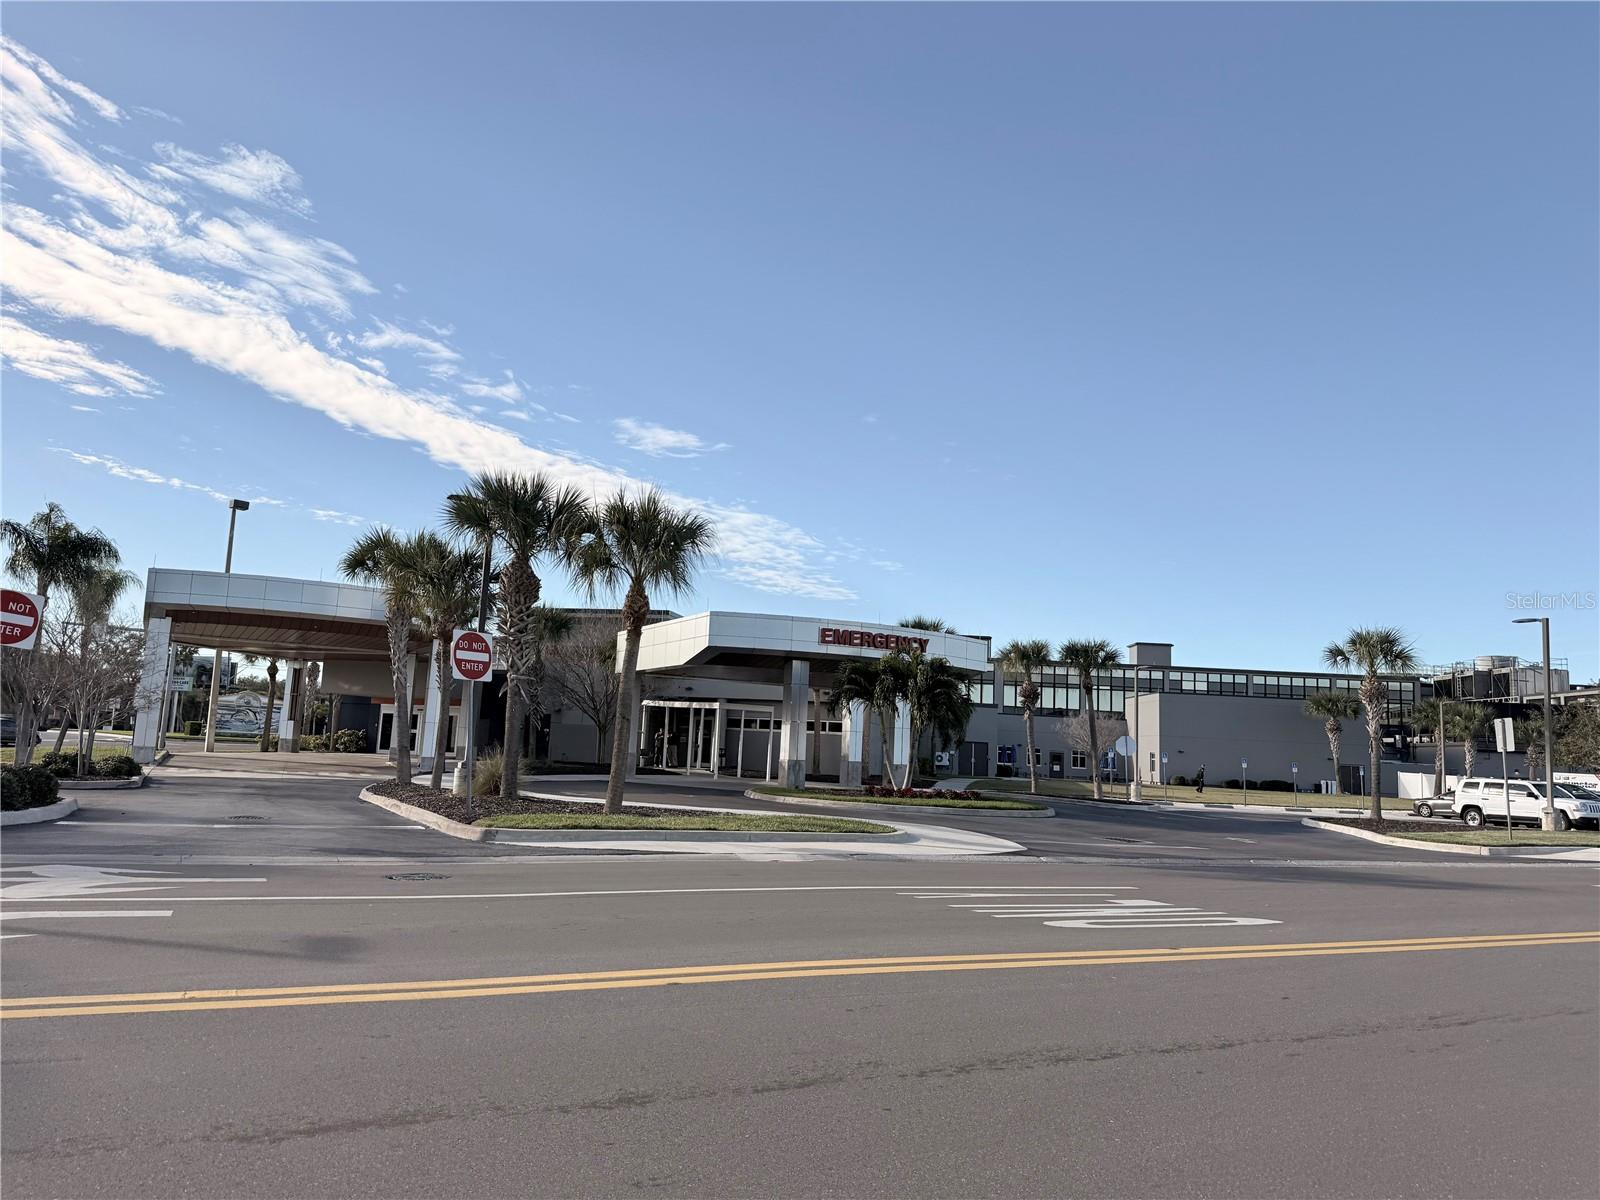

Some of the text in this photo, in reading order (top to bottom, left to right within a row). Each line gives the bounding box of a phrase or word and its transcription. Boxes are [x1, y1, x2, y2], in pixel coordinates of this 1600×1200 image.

[8, 602, 31, 613] NOT
[0, 625, 21, 636] TER
[459, 640, 486, 650] DO NOT
[819, 628, 929, 653] EMERGENCY
[461, 661, 484, 671] ENTER
